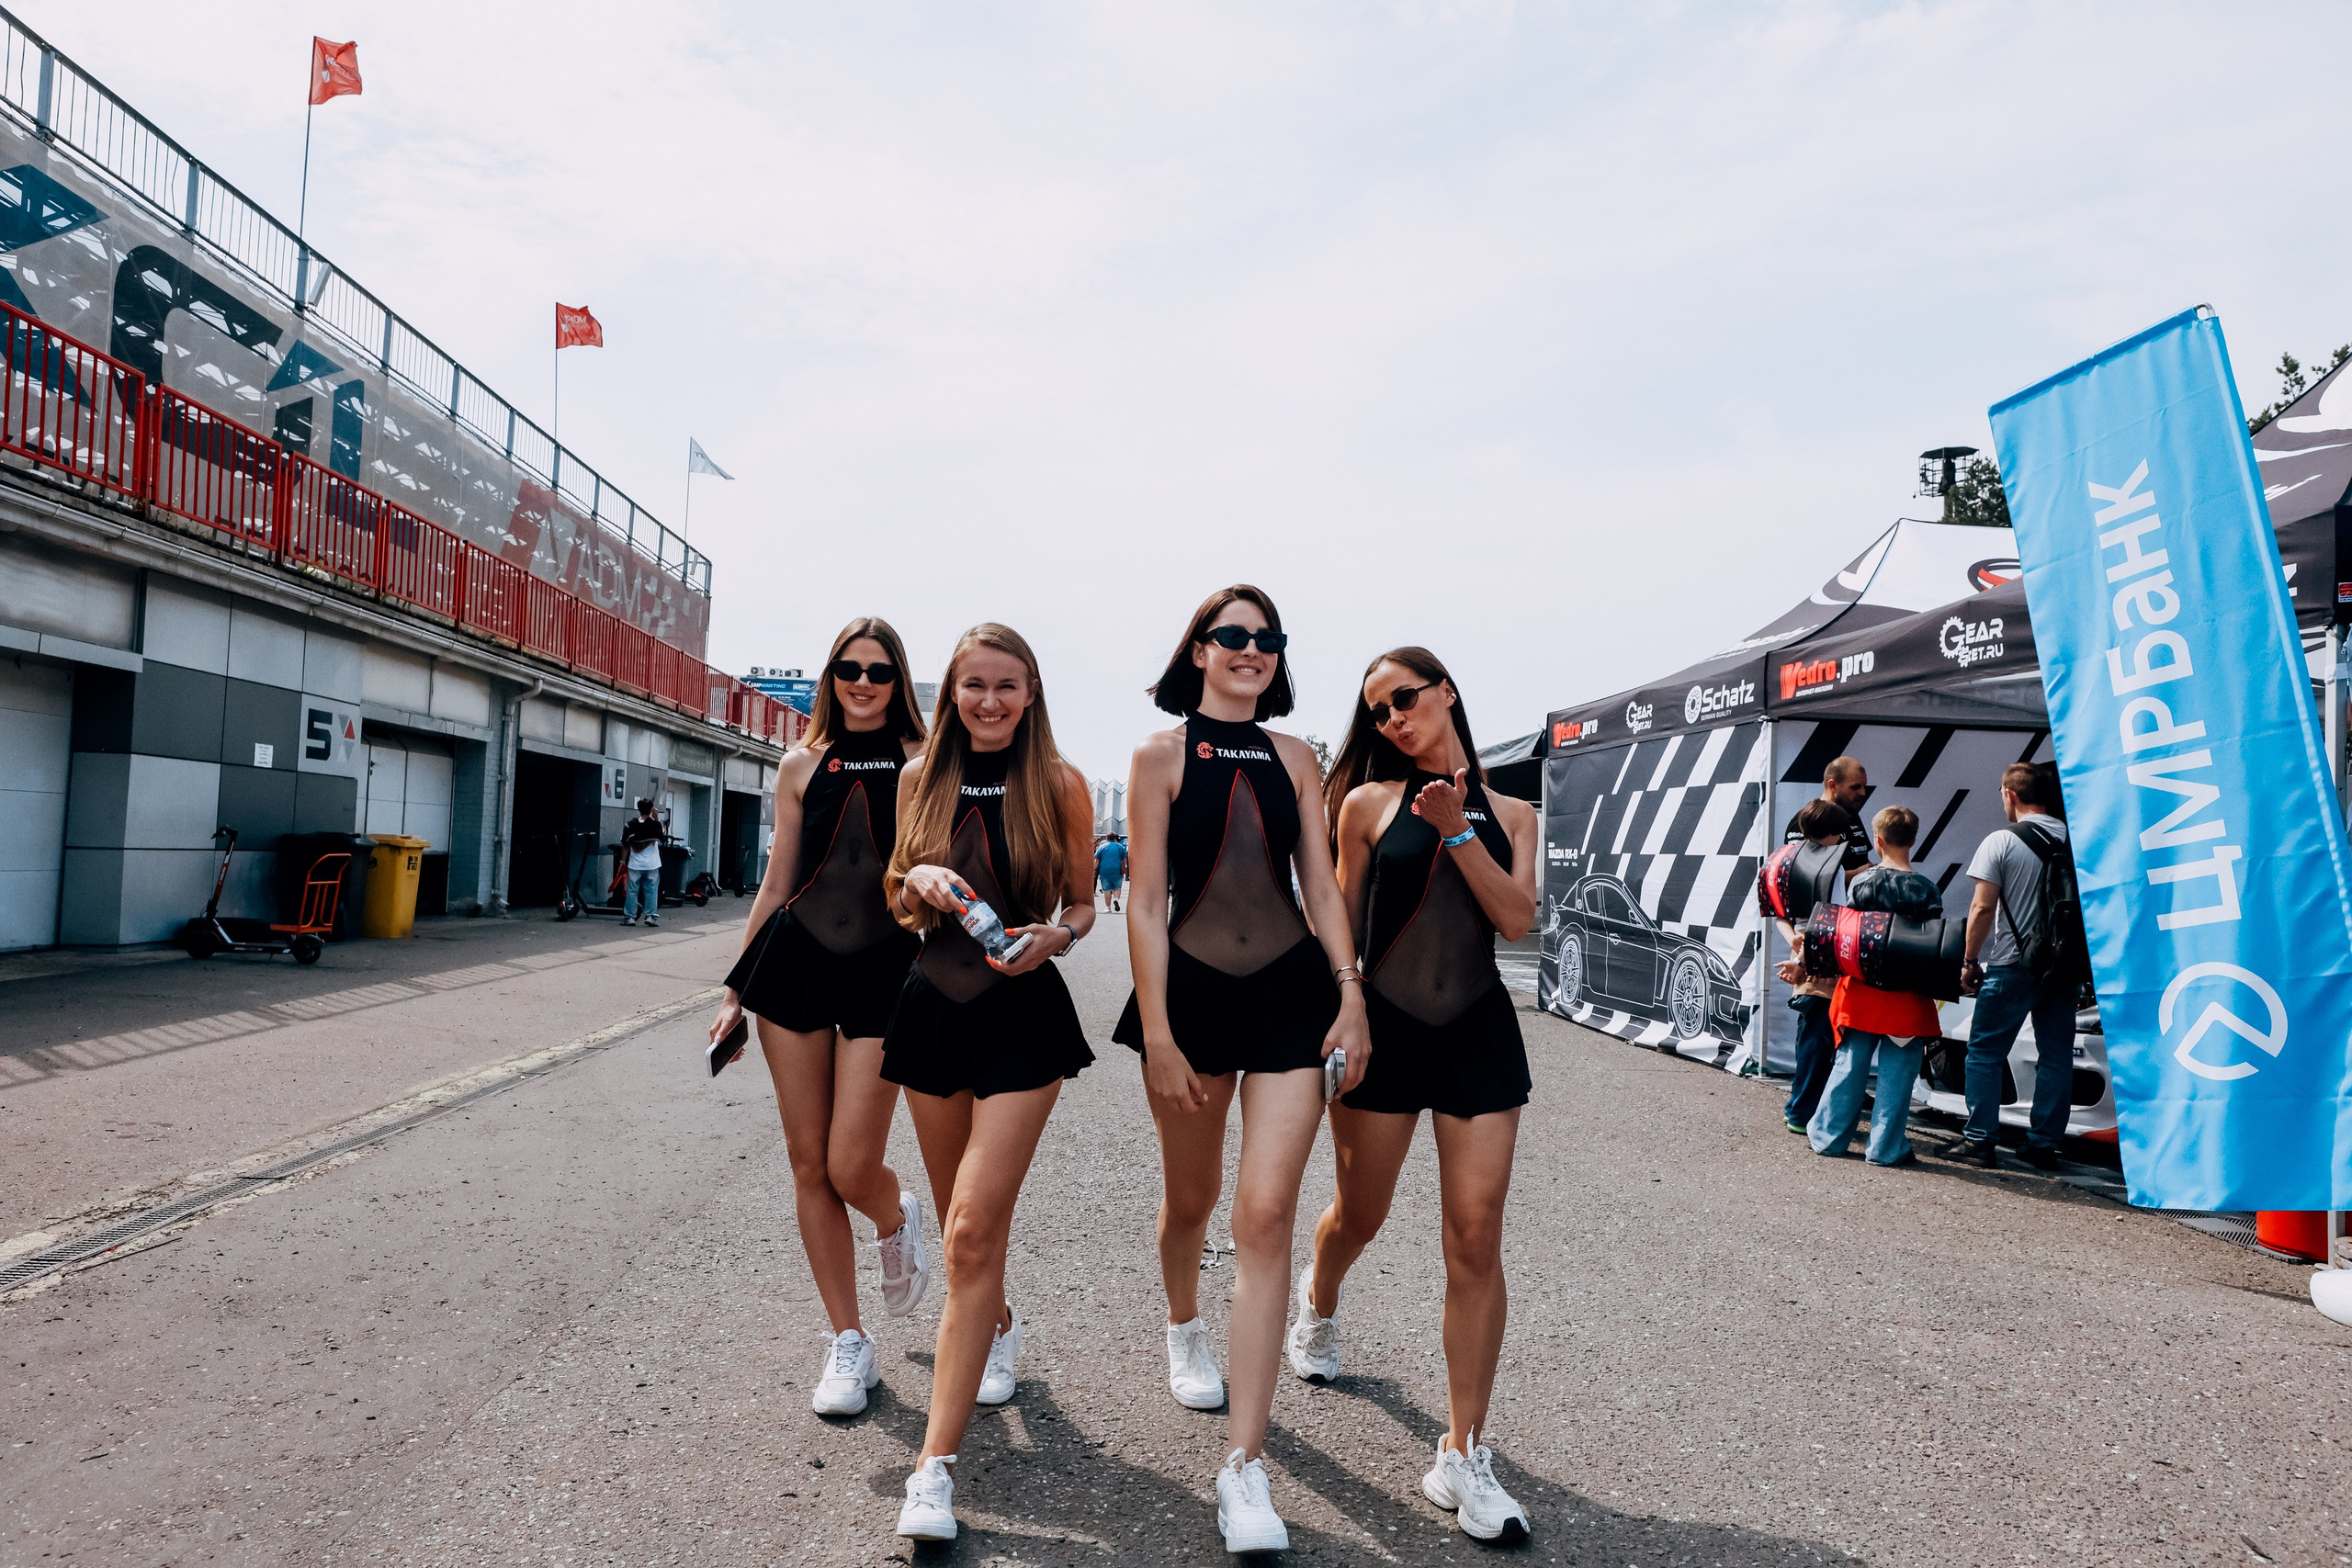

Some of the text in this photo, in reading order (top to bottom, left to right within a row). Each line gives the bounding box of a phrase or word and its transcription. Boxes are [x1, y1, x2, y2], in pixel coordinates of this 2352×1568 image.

[1939, 615, 2004, 660] GEAR
[1781, 651, 1874, 700] Vedro.pro
[1701, 680, 1755, 713] Schatz
[2087, 457, 2243, 931] ЦМРБанк
[1625, 701, 1653, 729] GEAR
[306, 707, 333, 761] 5
[1553, 718, 1599, 748] Vedro.pro
[843, 761, 896, 770] TAKAYAMA
[1216, 748, 1272, 761] TAKAYAMA
[615, 768, 625, 800] 6
[1840, 933, 1852, 960] RDS
